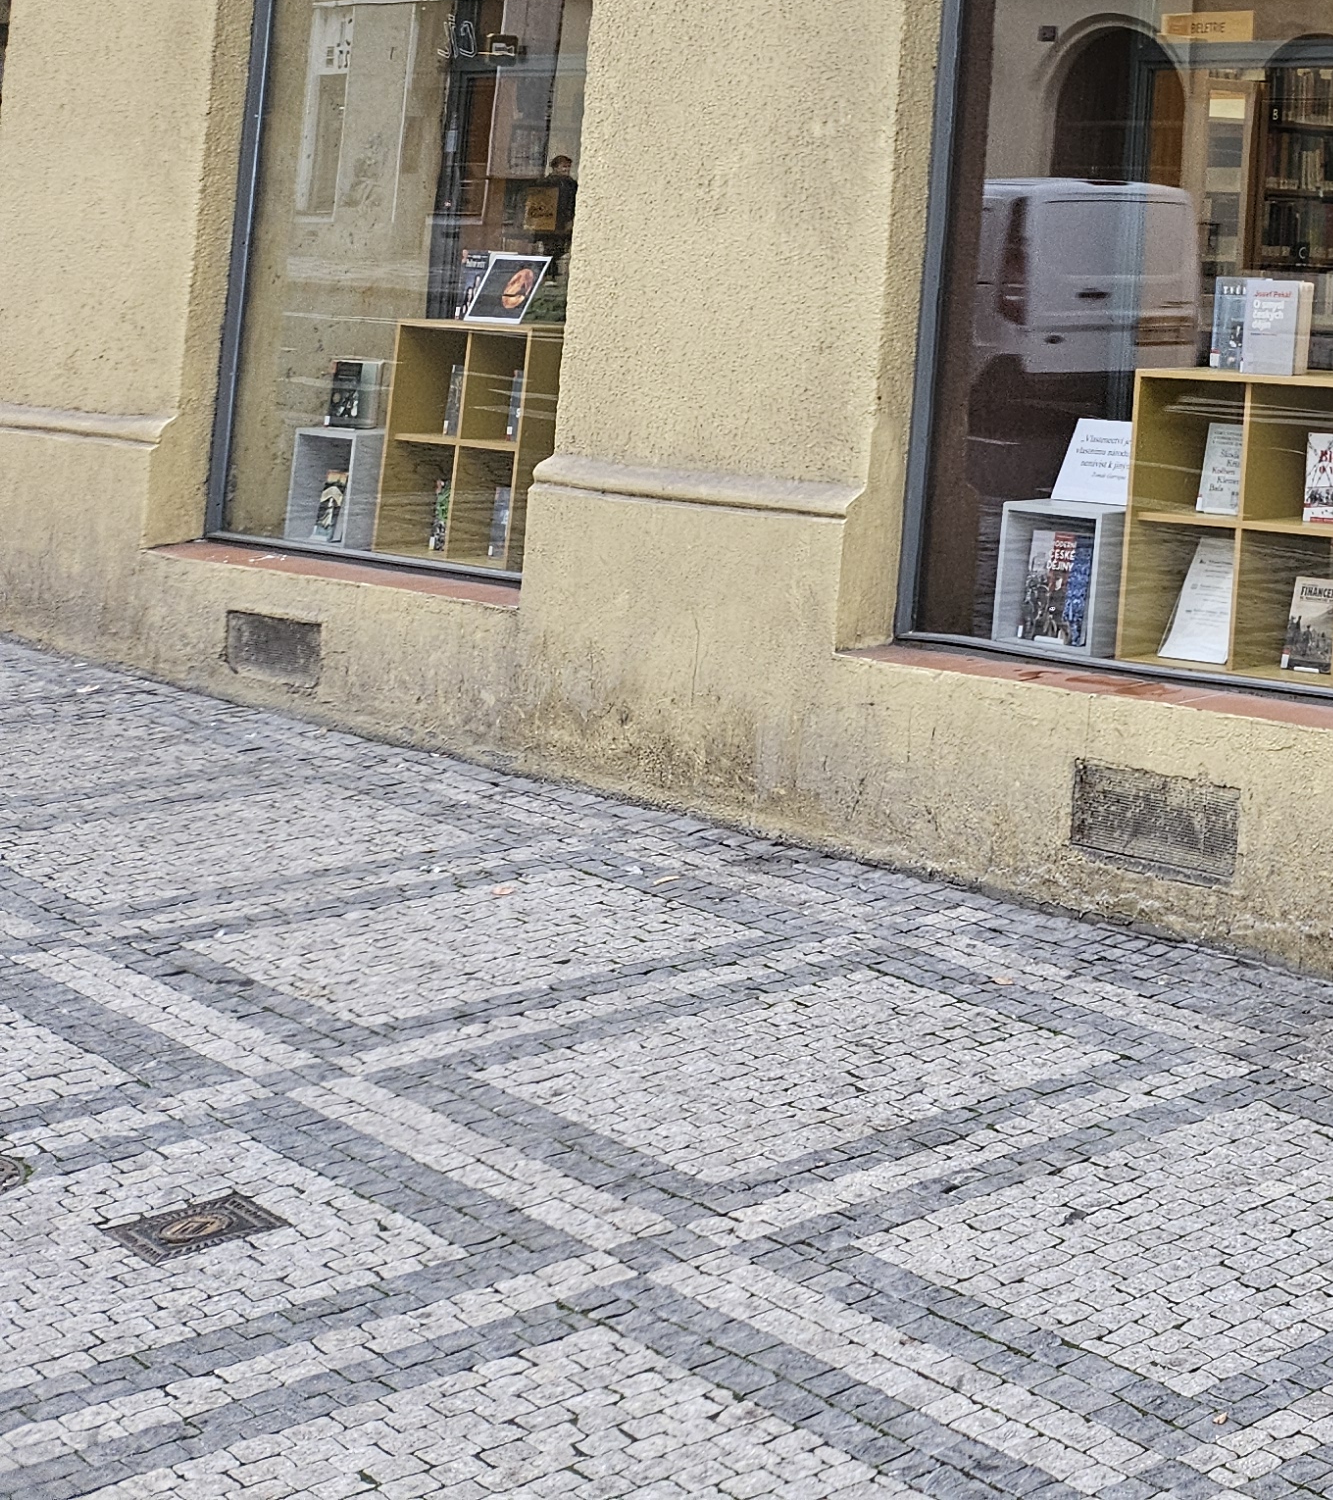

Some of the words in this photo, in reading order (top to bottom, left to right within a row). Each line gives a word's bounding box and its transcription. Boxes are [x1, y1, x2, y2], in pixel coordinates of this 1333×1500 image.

[1190, 22, 1226, 34] BELETRIE
[1272, 109, 1279, 120] B
[1049, 548, 1076, 560] ČESKÉ
[1046, 559, 1075, 572] DĚJINY
